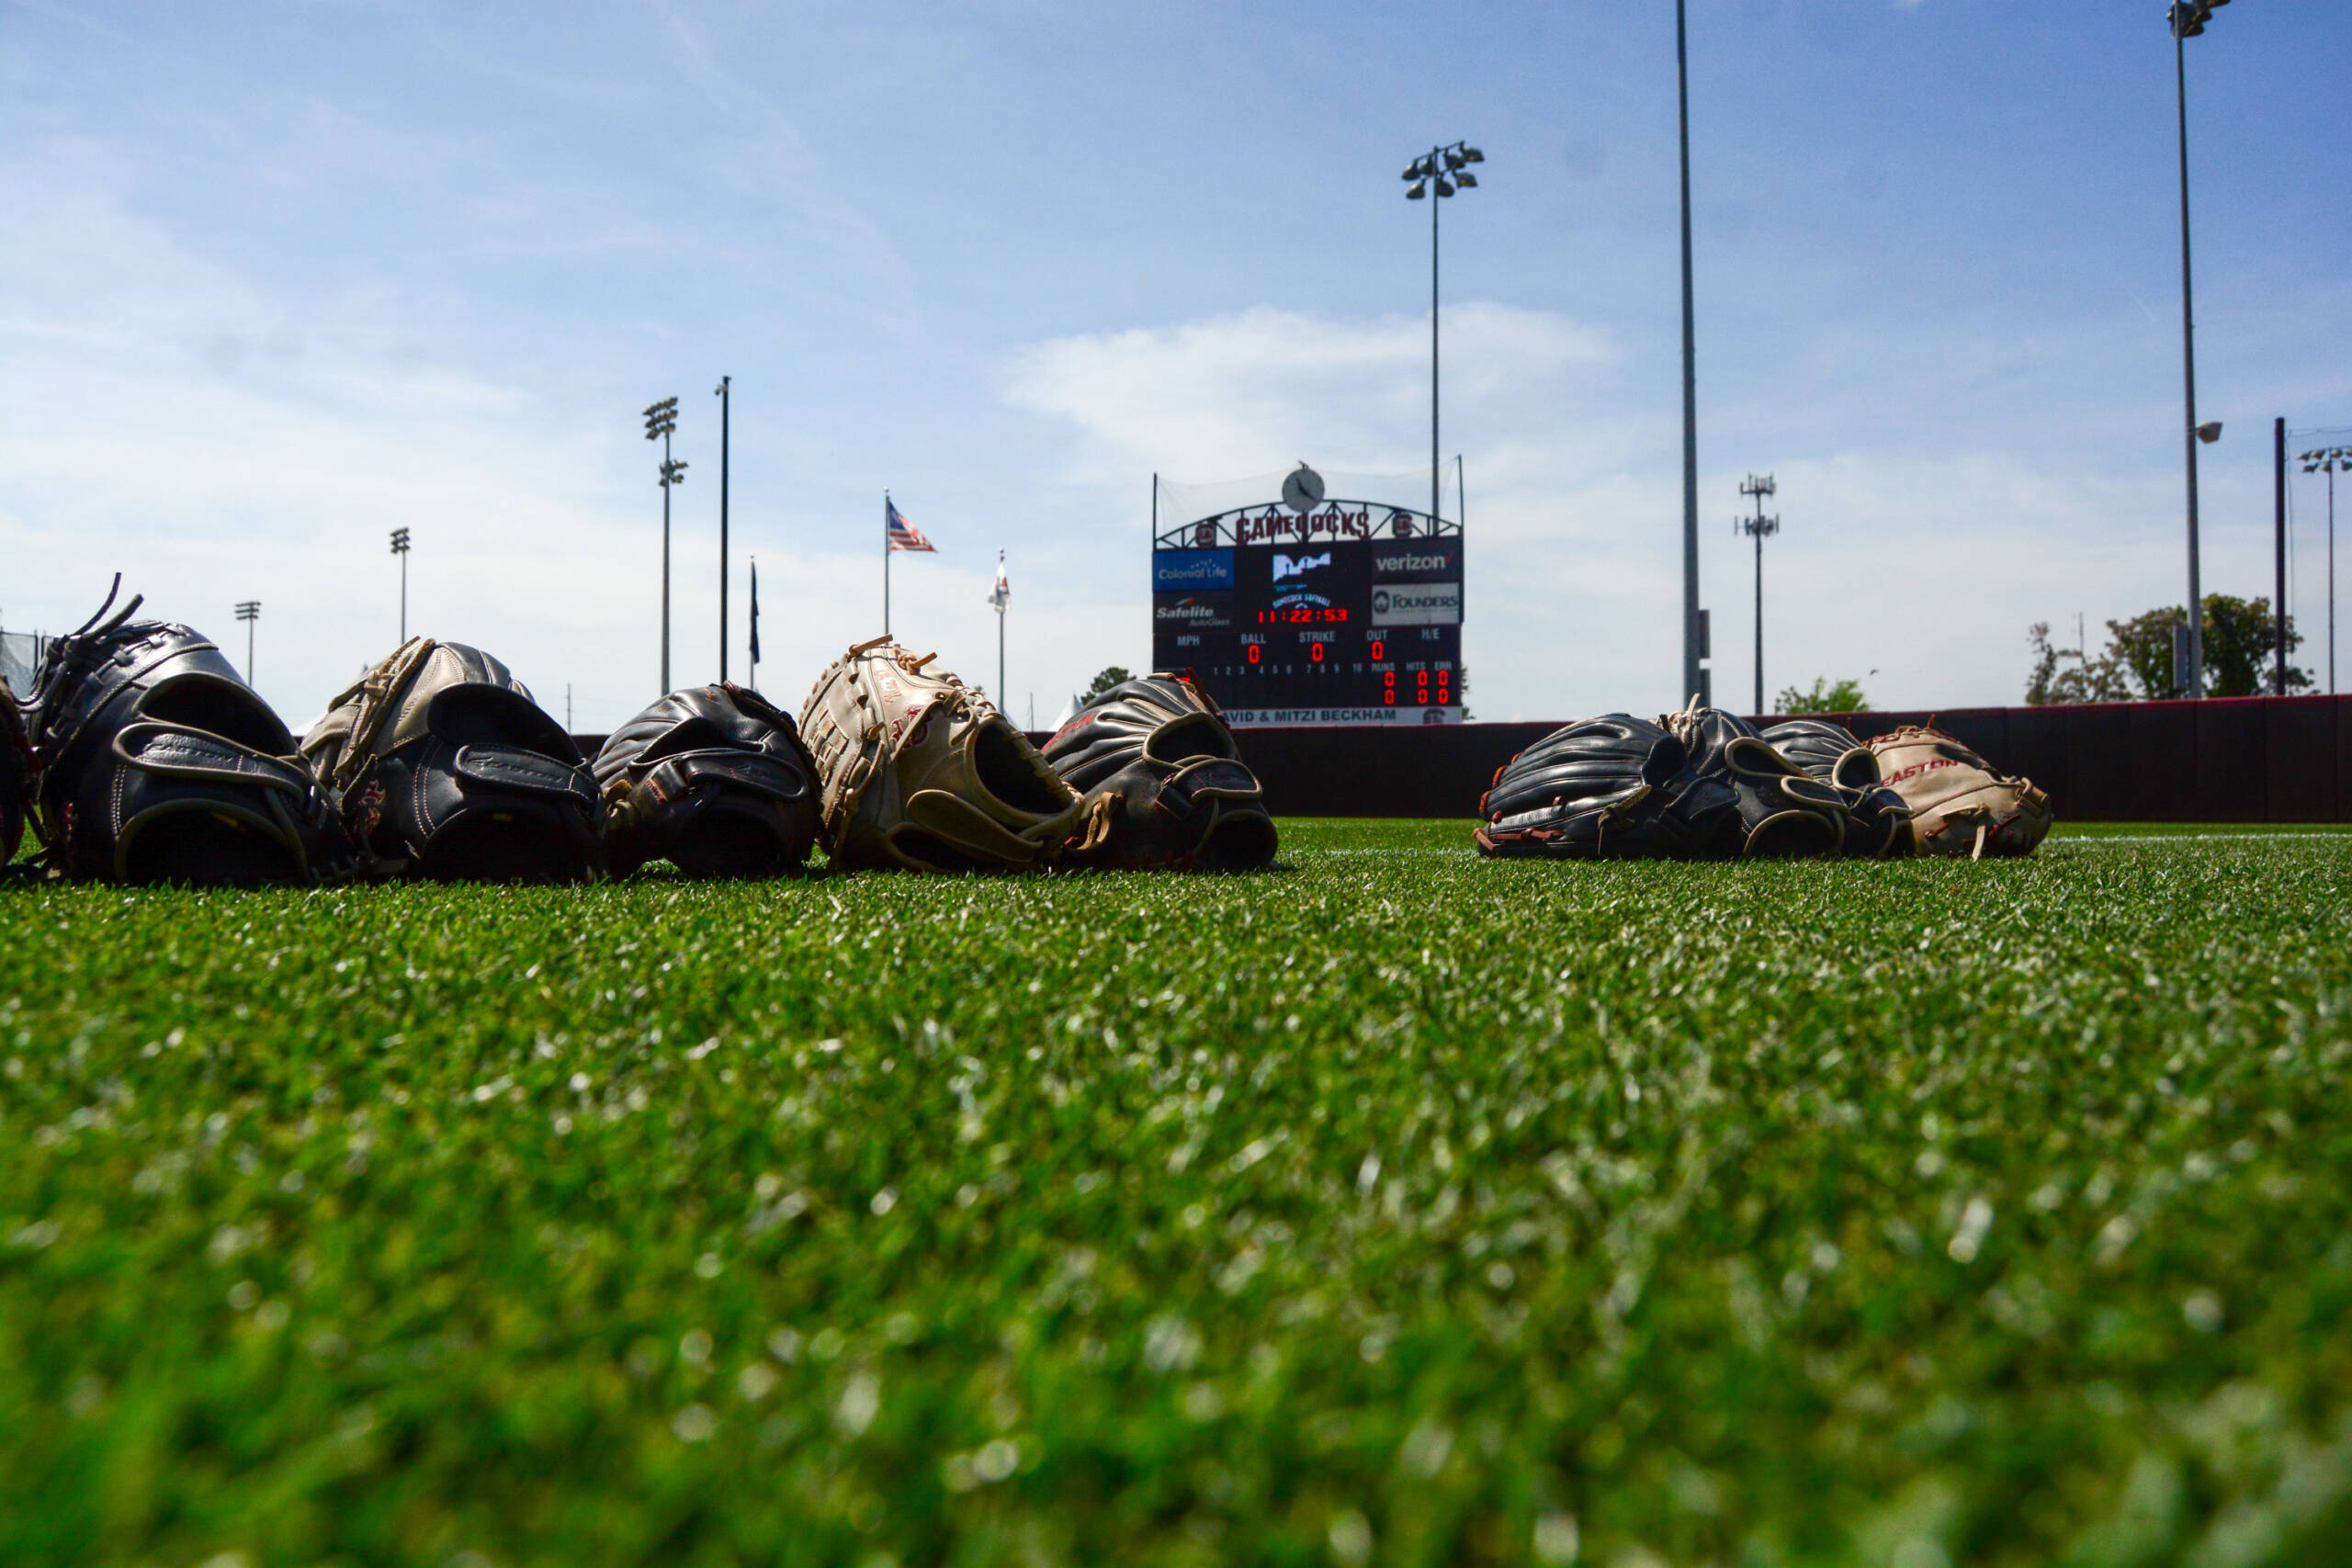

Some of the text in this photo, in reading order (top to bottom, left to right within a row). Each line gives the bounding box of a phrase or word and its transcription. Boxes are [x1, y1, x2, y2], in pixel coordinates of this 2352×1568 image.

[1236, 511, 1370, 546] GAMECOCKS
[1376, 553, 1446, 571] verizon
[1159, 567, 1227, 580] Colonial Life
[1157, 606, 1215, 618] Safelite
[1258, 608, 1348, 624] 11:22:53
[1177, 635, 1201, 647] MPH
[1240, 633, 1267, 644] BALL
[1298, 631, 1337, 643] STRIKE
[1366, 629, 1388, 641] OUT
[1421, 627, 1441, 640] H/E
[1249, 644, 1260, 663] 0
[1312, 643, 1323, 661] 0
[1372, 641, 1384, 660] 0
[1214, 660, 1453, 676] 1 2 3 4 5 6 7 8 9 10 RUNS HITS ERR
[1385, 670, 1448, 687] 0 0 0
[1385, 688, 1448, 705] 0 0 0
[1223, 709, 1396, 723] AVID & MITZI BECKHAM
[1881, 759, 1959, 787] EASTON
